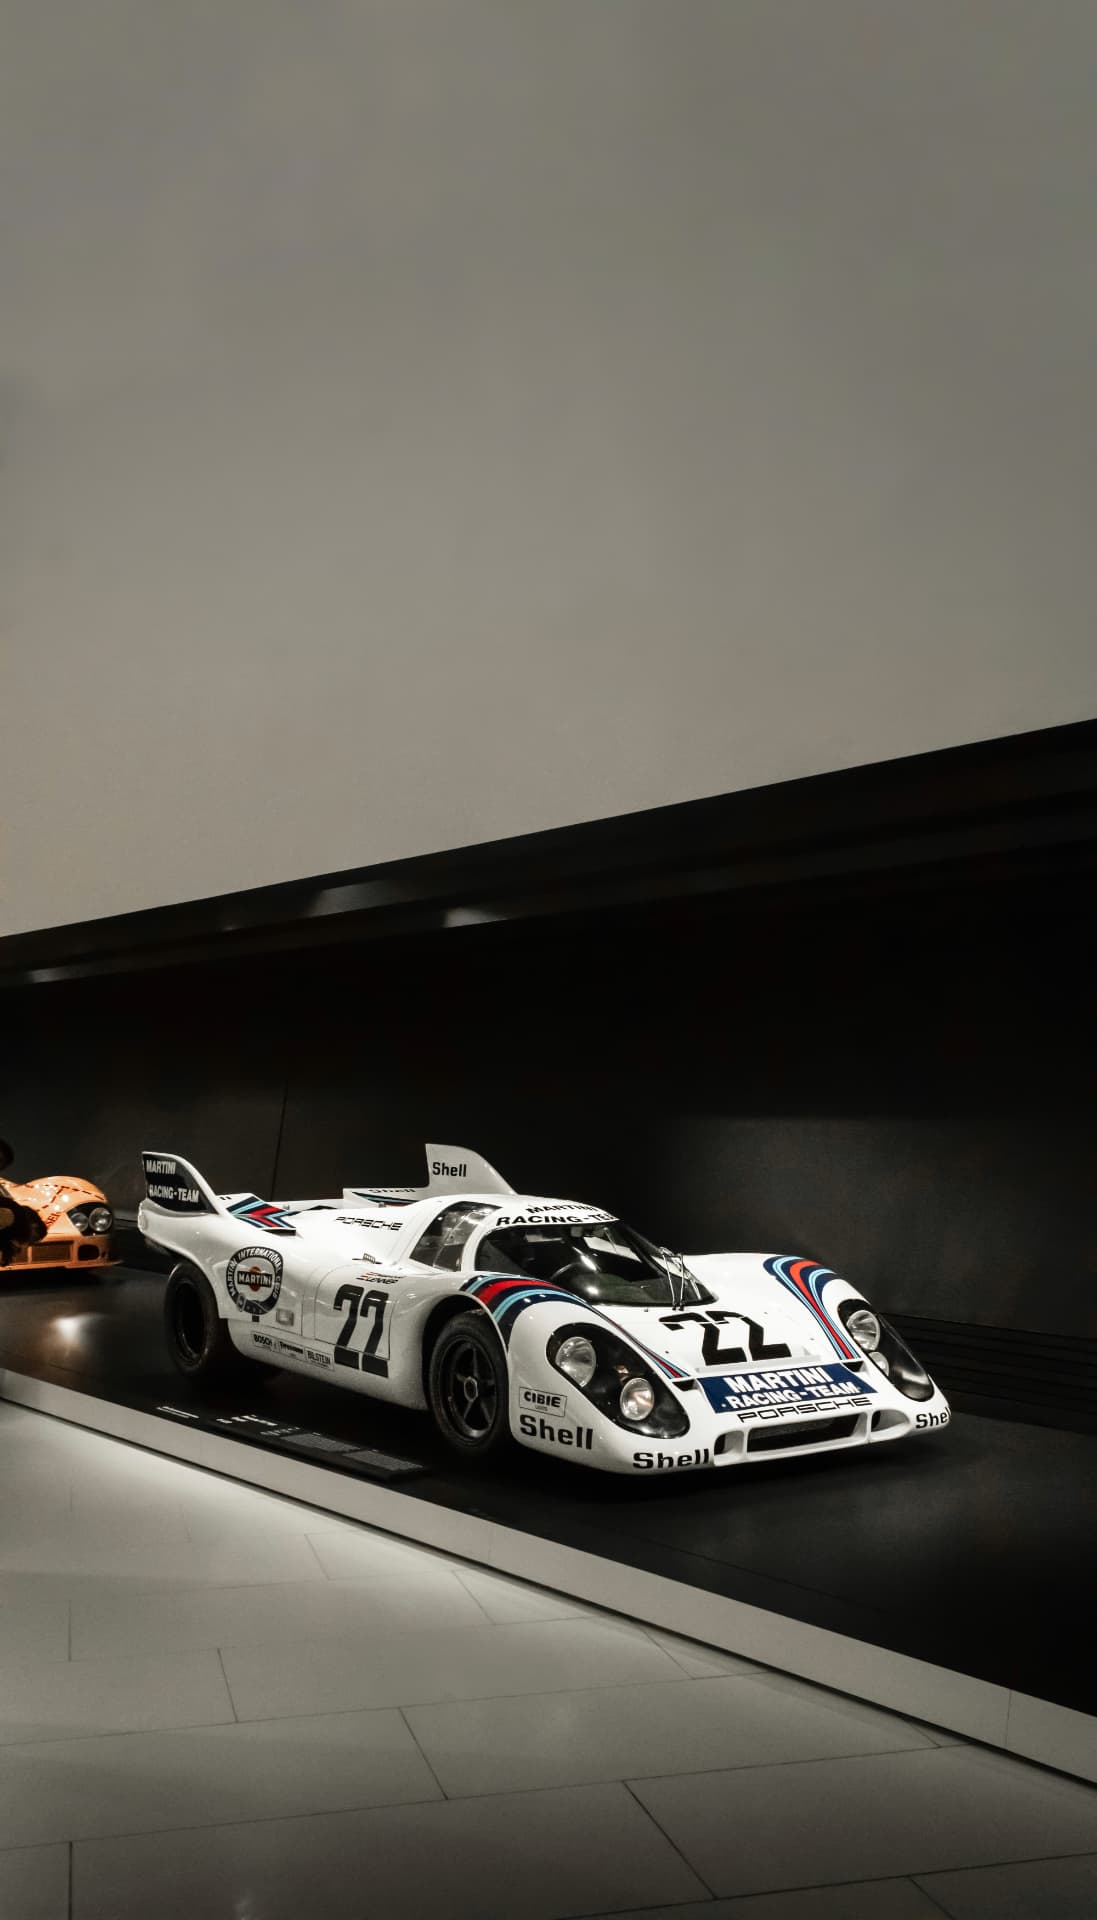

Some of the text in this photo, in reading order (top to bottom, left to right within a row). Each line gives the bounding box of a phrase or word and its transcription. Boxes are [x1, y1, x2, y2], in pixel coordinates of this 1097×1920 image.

[146, 1160, 177, 1174] MARTINI
[432, 1161, 467, 1177] Shell
[148, 1184, 200, 1203] RACING-TEAM
[337, 1216, 403, 1231] PORSCHE
[238, 1273, 272, 1286] MARTINI
[333, 1283, 390, 1379] 22
[658, 1310, 792, 1366] 22
[723, 1366, 834, 1393] MARTINI
[523, 1391, 561, 1408] CIBIE
[736, 1397, 873, 1424] PORSCHE
[519, 1414, 593, 1450] Shell
[633, 1449, 709, 1468] Shell
